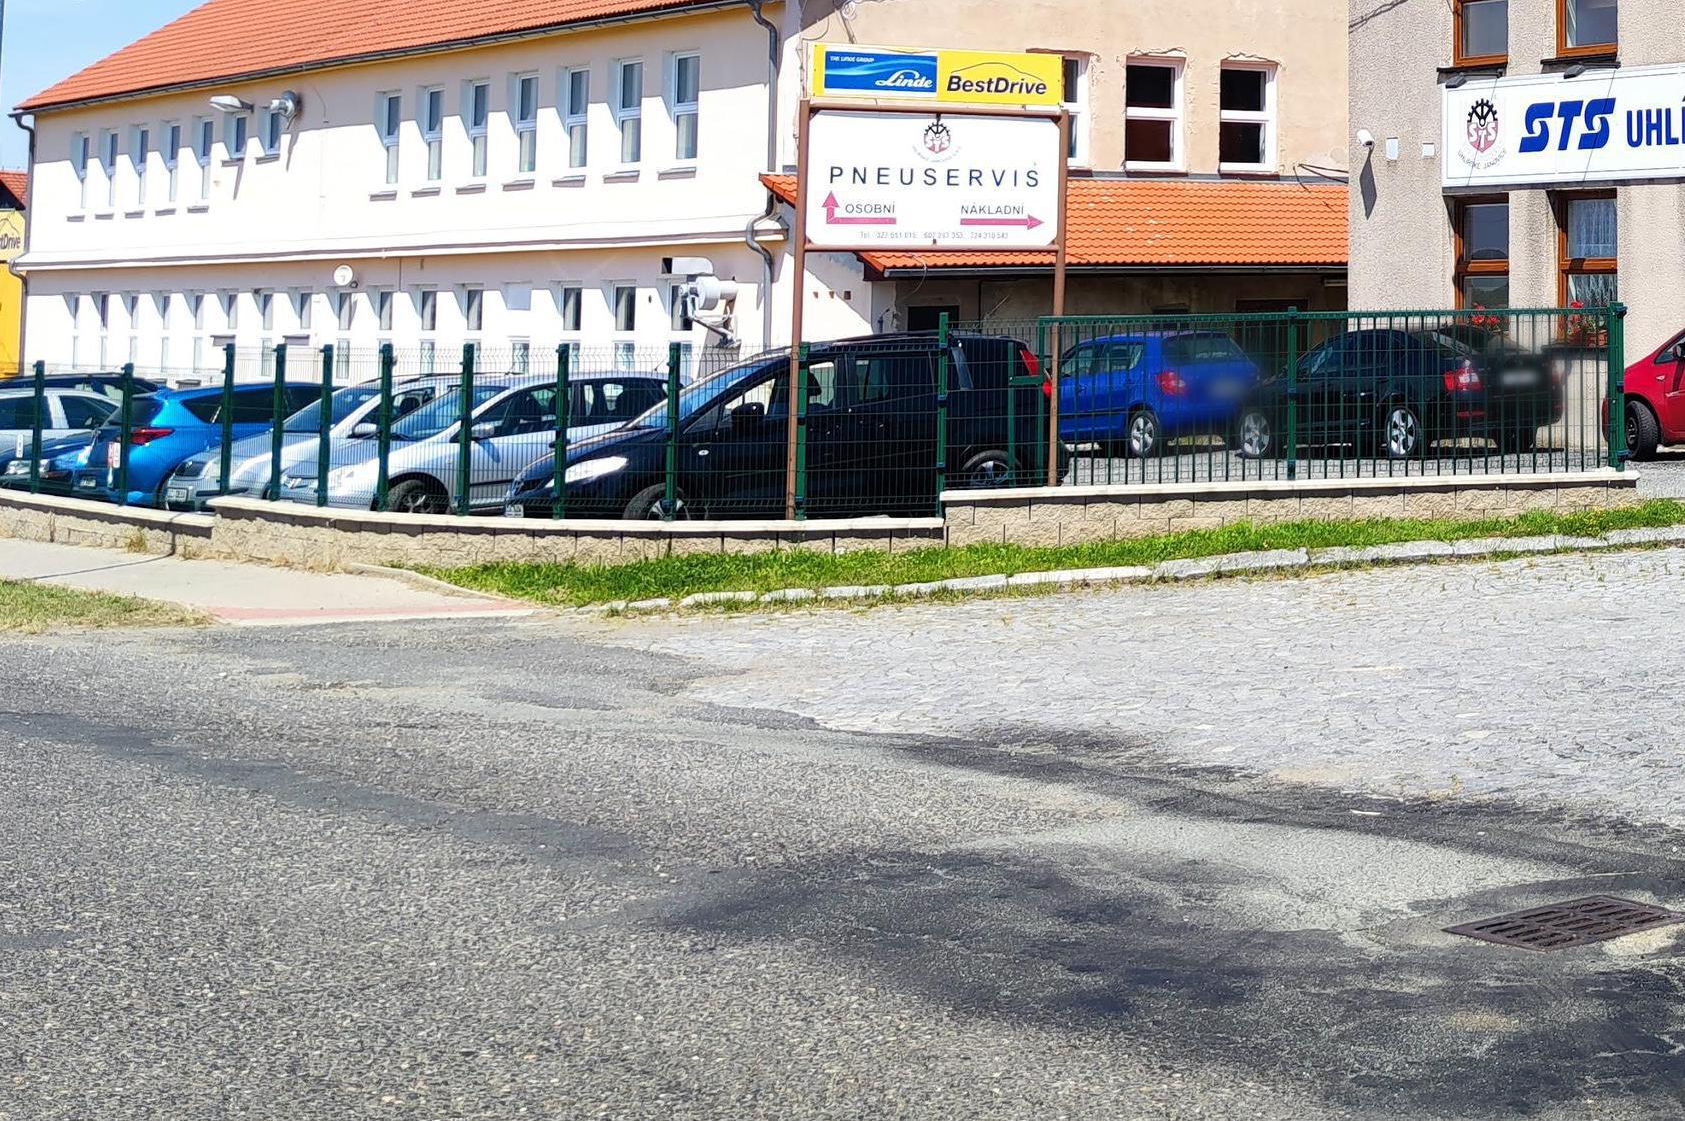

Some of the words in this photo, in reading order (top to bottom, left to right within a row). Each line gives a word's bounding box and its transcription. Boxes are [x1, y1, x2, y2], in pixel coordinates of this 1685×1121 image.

[875, 69, 933, 88] Linde
[947, 75, 1047, 95] BestDrive
[1468, 122, 1497, 149] STS
[1518, 98, 1616, 153] STS
[829, 166, 1039, 188] PNEUSERVIS
[845, 201, 896, 214] OSOBNÍ
[960, 202, 1025, 215] NÁKLADNÍ
